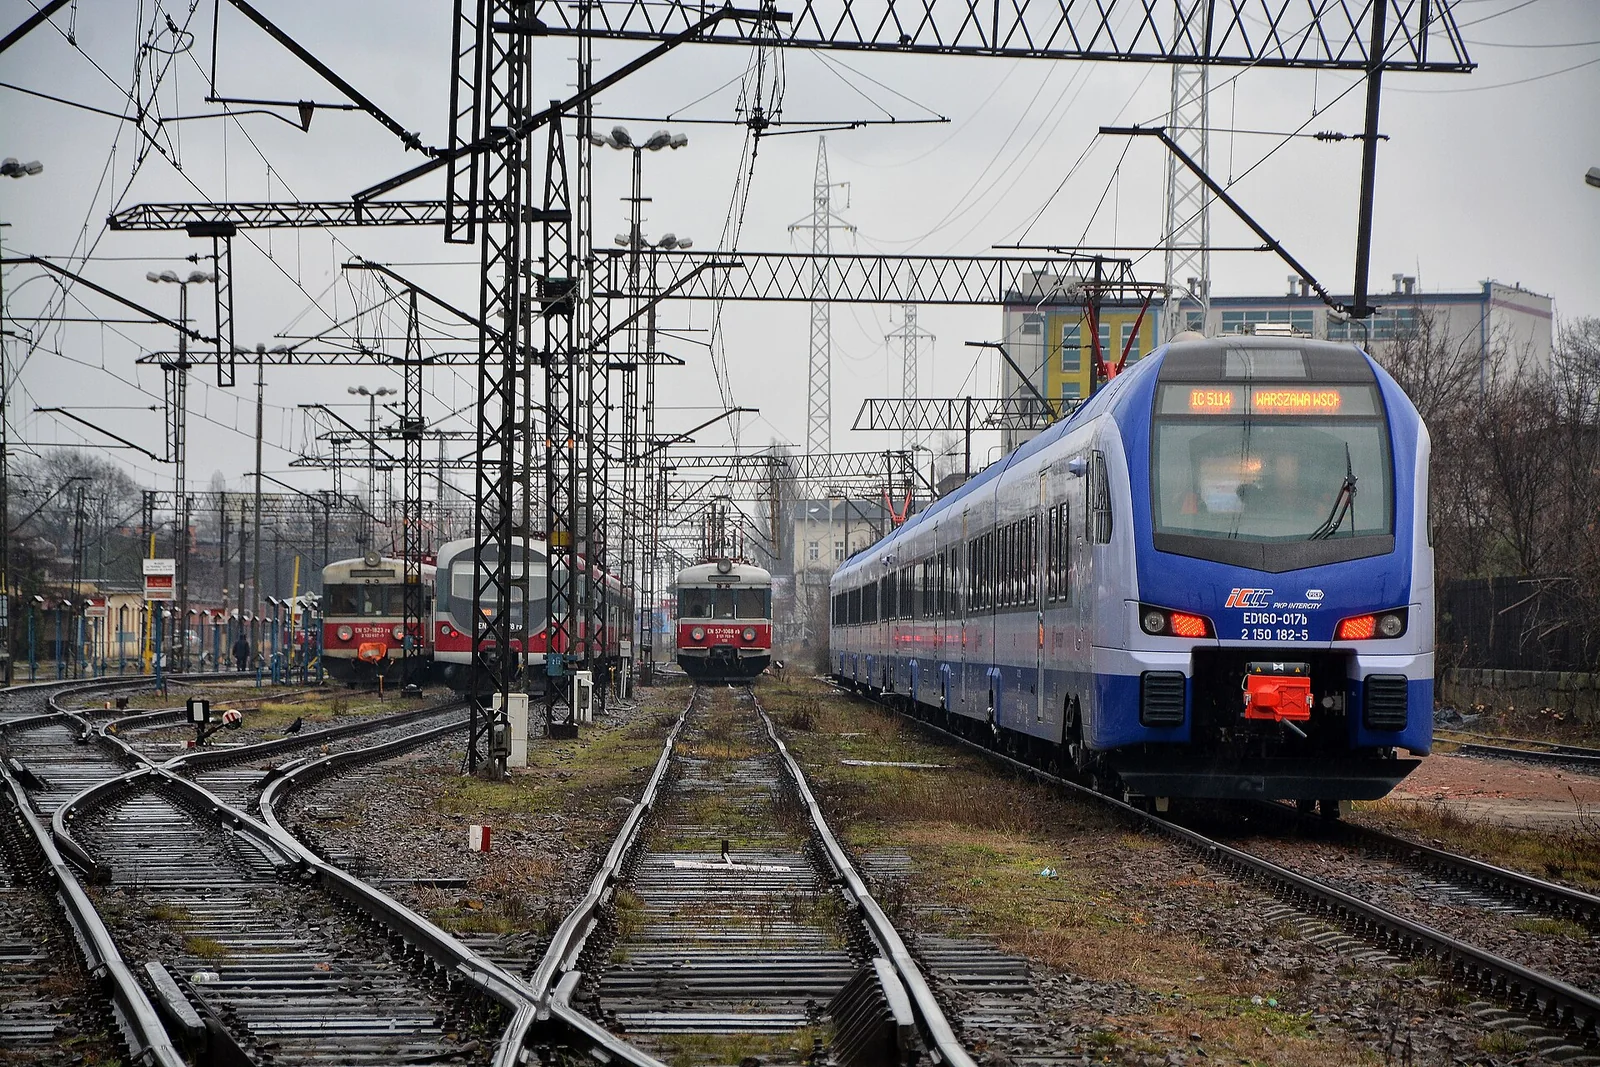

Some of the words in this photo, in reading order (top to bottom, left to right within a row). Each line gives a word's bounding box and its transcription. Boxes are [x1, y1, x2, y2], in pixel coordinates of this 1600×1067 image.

[1192, 392, 1204, 406] IC
[1207, 392, 1231, 406] 5114
[1256, 392, 1311, 407] WARSZAWA
[1243, 612, 1308, 625] ED160-017b
[479, 622, 487, 630] EN
[1241, 629, 1249, 640] 2
[1252, 629, 1271, 640] 150
[1276, 629, 1309, 641] 182-5
